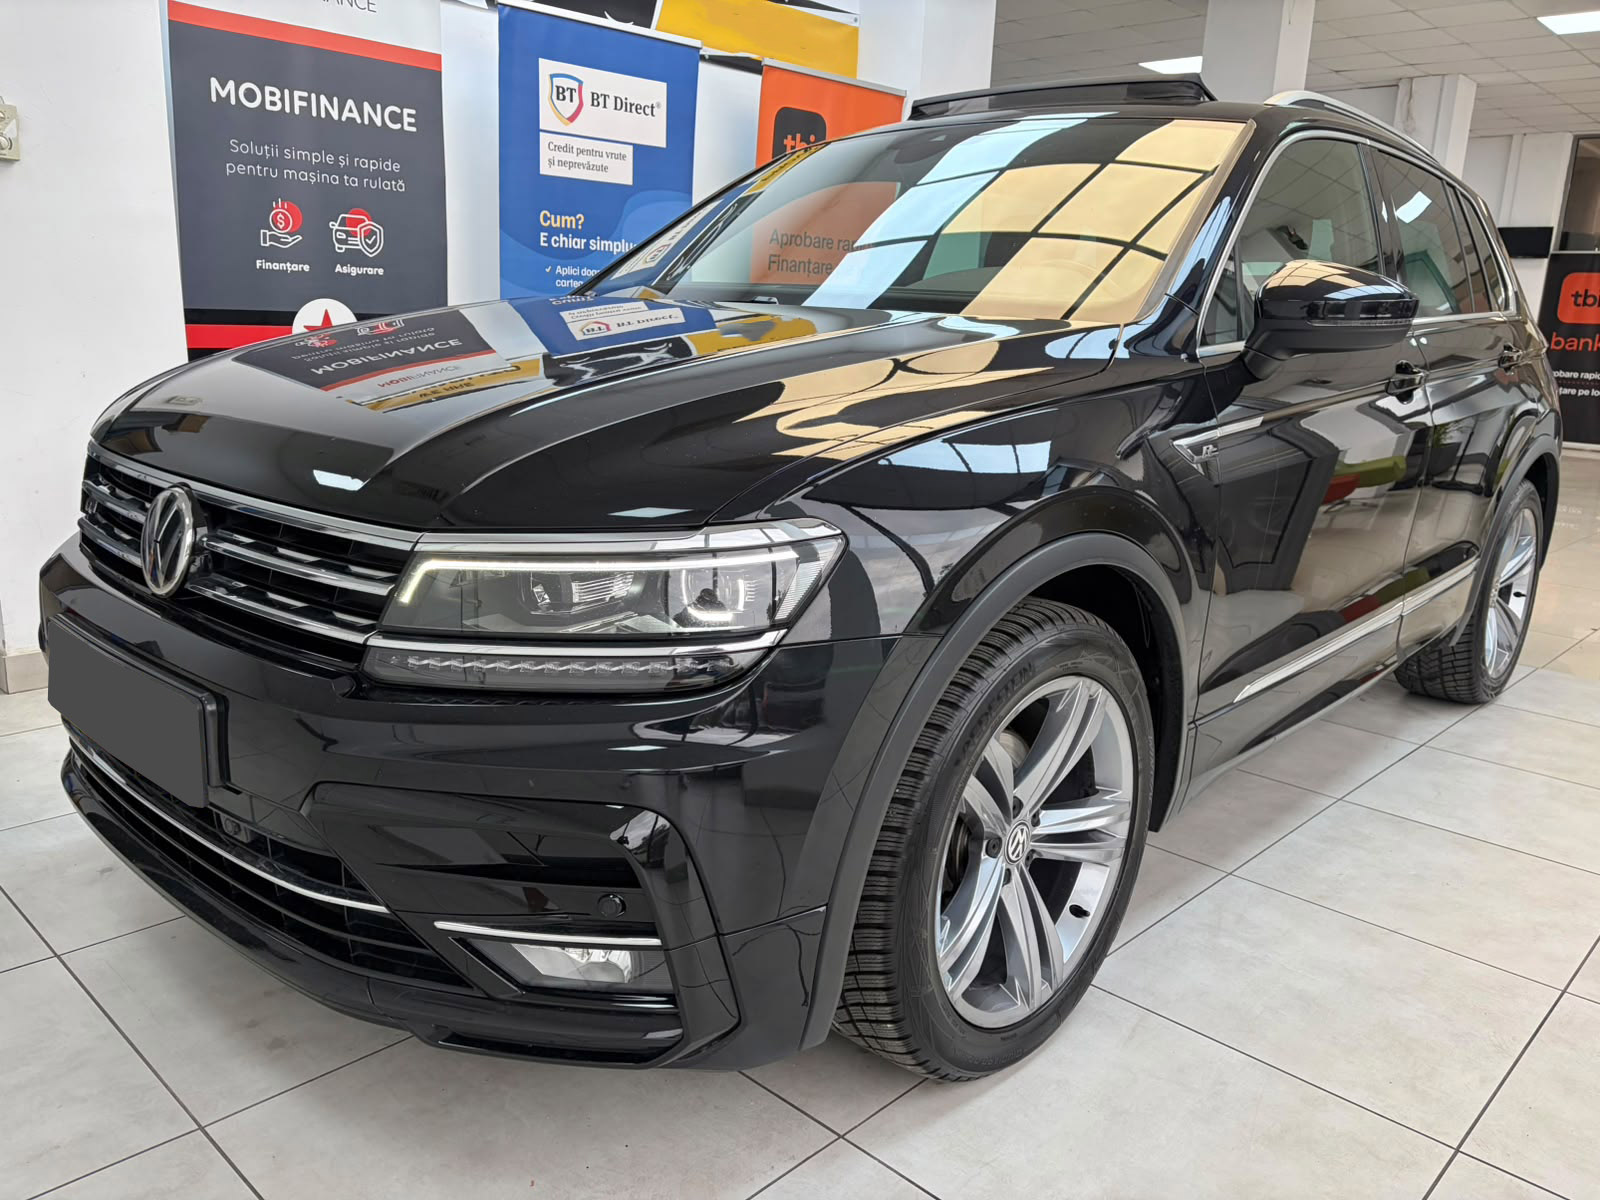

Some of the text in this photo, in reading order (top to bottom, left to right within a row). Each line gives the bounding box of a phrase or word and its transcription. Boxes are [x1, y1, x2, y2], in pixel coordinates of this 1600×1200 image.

[209, 77, 417, 132] MOBIFINANCE
[555, 85, 576, 103] BT
[590, 91, 610, 109] BT
[230, 139, 279, 159] Soluții
[283, 146, 335, 166] simple
[354, 157, 401, 173] rapide
[547, 140, 628, 162] Credit pentru vrute
[226, 162, 279, 178] pentru
[283, 169, 340, 185] mașina
[343, 174, 359, 187] ta
[539, 210, 585, 230] Cum?
[539, 232, 549, 247] E
[551, 235, 587, 250] chiar
[589, 236, 637, 255] simplu
[769, 228, 834, 251] Aprobare
[335, 263, 384, 276] Asigurare
[555, 265, 580, 277] Aplici
